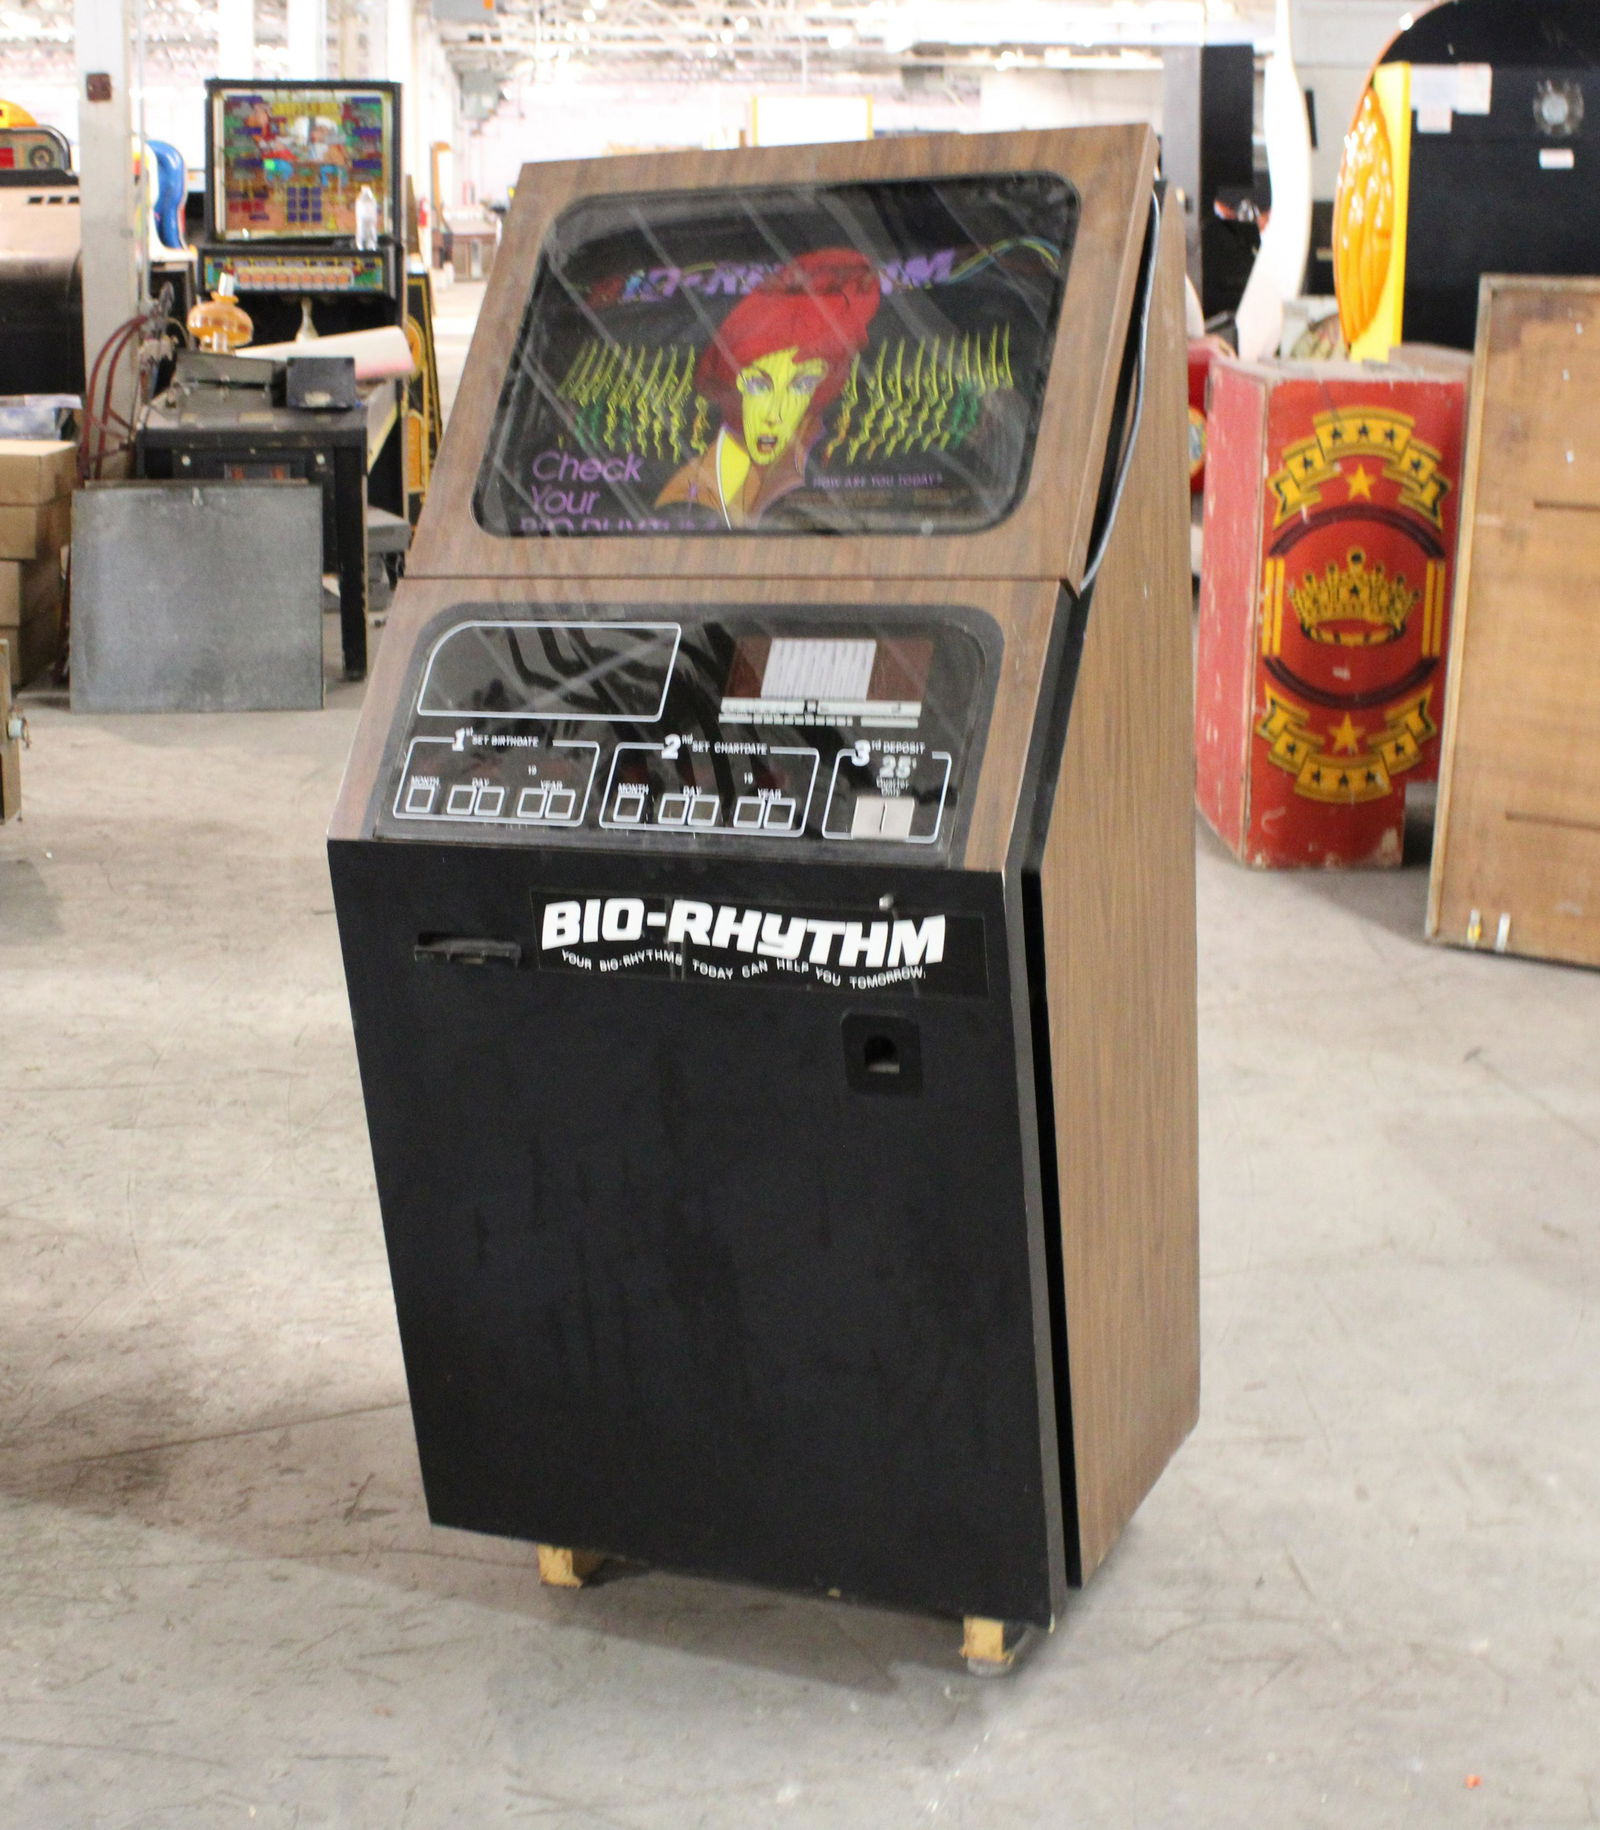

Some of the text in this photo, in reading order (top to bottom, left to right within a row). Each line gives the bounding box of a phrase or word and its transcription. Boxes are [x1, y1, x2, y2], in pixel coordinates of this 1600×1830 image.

[532, 451, 644, 482] Check
[531, 485, 601, 514] Your
[472, 734, 489, 747] SET
[491, 734, 540, 748] BIRTHDATE
[692, 740, 711, 753] SET
[714, 741, 768, 756] CHARTDATE
[883, 741, 925, 754] DEPOSIT
[410, 775, 563, 791] MONTH DAY YEAR
[617, 782, 782, 800] MONTH DAY YEAR
[541, 897, 946, 969] BIO-RHYTHM
[561, 949, 593, 971] YOUR
[692, 958, 734, 981] TODAY
[741, 959, 768, 979] CAN
[776, 957, 810, 974] HELP
[815, 966, 842, 988] YOU
